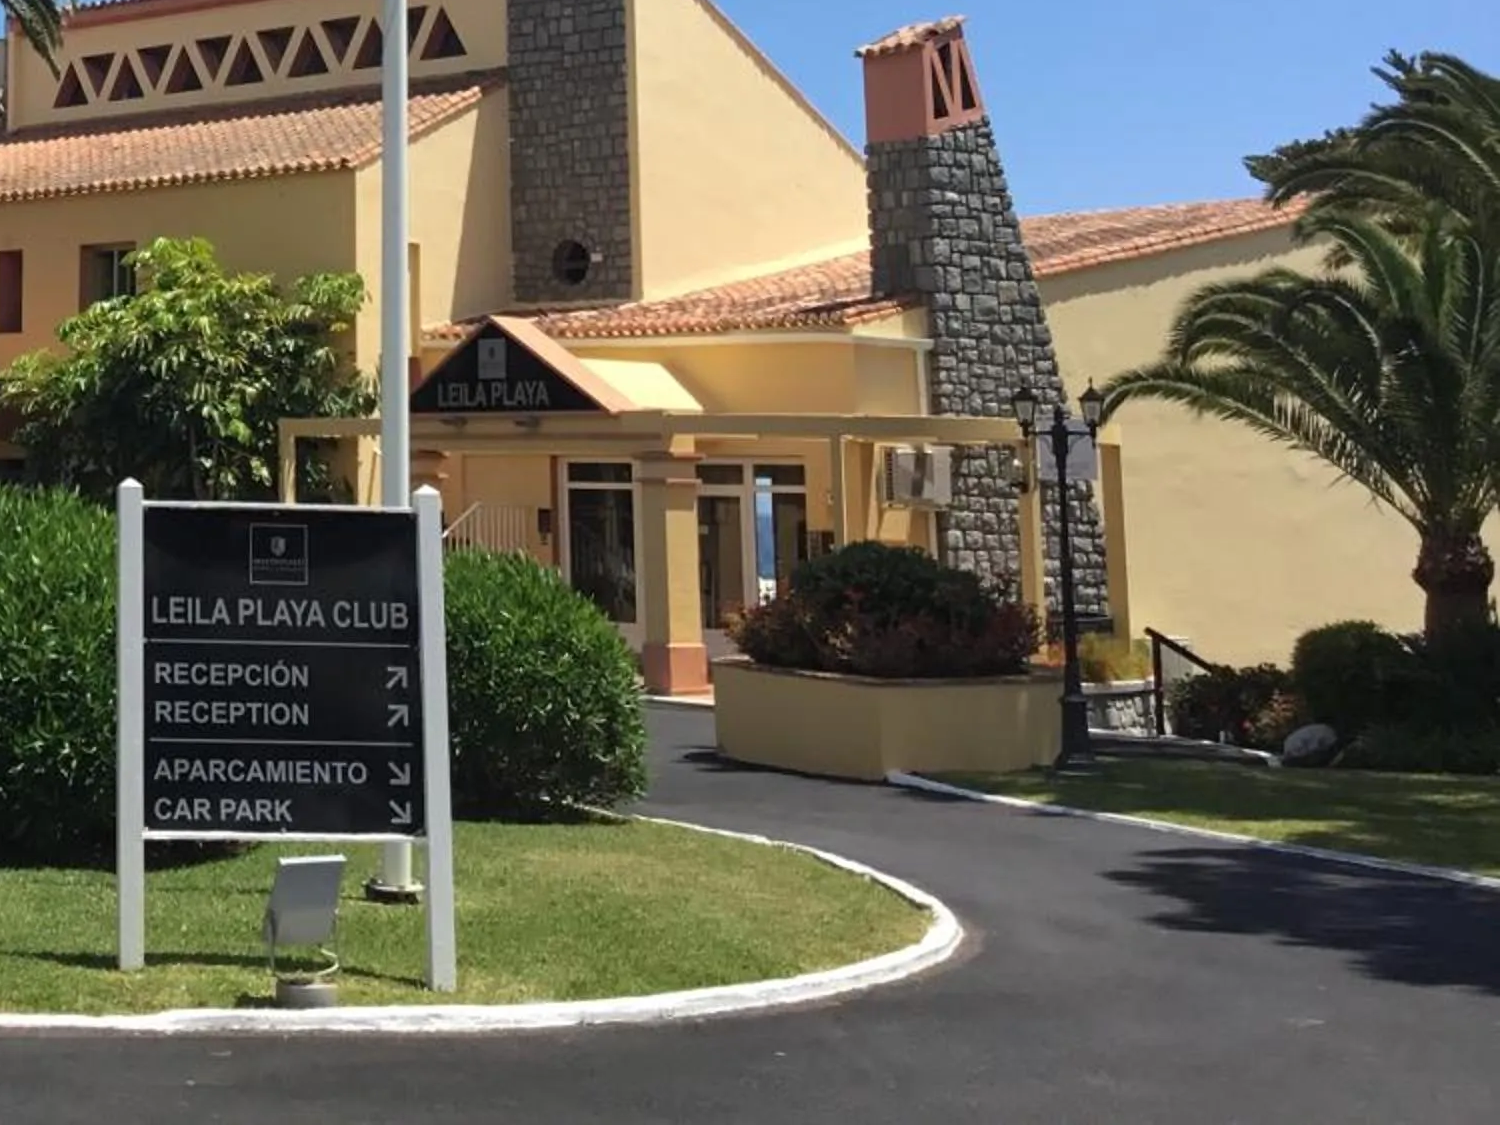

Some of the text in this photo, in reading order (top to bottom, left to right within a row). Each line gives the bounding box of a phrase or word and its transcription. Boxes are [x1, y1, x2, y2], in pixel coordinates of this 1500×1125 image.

[437, 380, 550, 408] LEILA PLAYA
[151, 595, 409, 630] LEILA PLAYA CLUB
[154, 659, 309, 688] RECEPCIÓN
[154, 702, 309, 726] RECEPTION
[153, 758, 368, 785] APARCAMIENTO
[154, 798, 293, 823] CAR PARK
